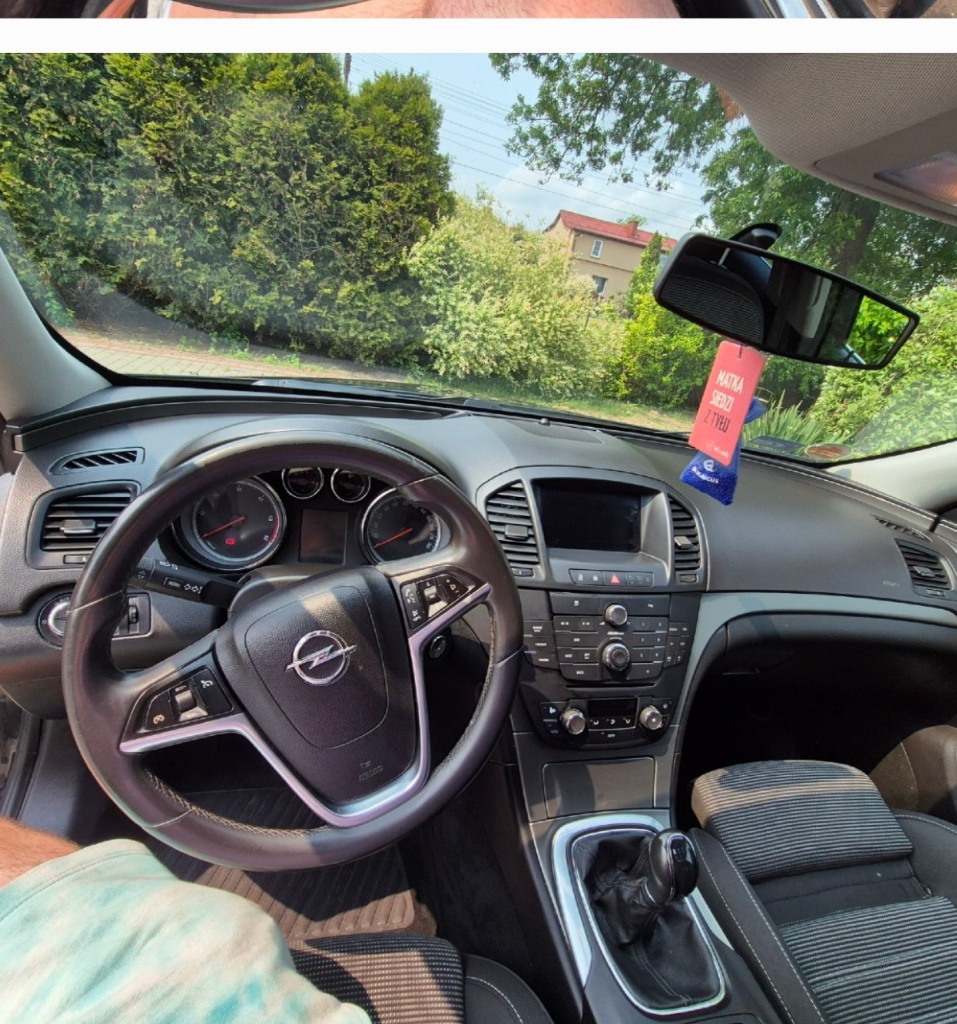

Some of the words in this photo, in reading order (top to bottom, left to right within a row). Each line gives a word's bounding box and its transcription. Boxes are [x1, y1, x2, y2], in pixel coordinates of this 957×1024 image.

[716, 370, 745, 395] MATKA
[710, 390, 735, 412] SIEDZI
[704, 409, 711, 423] Z
[712, 412, 731, 433] TYŁU
